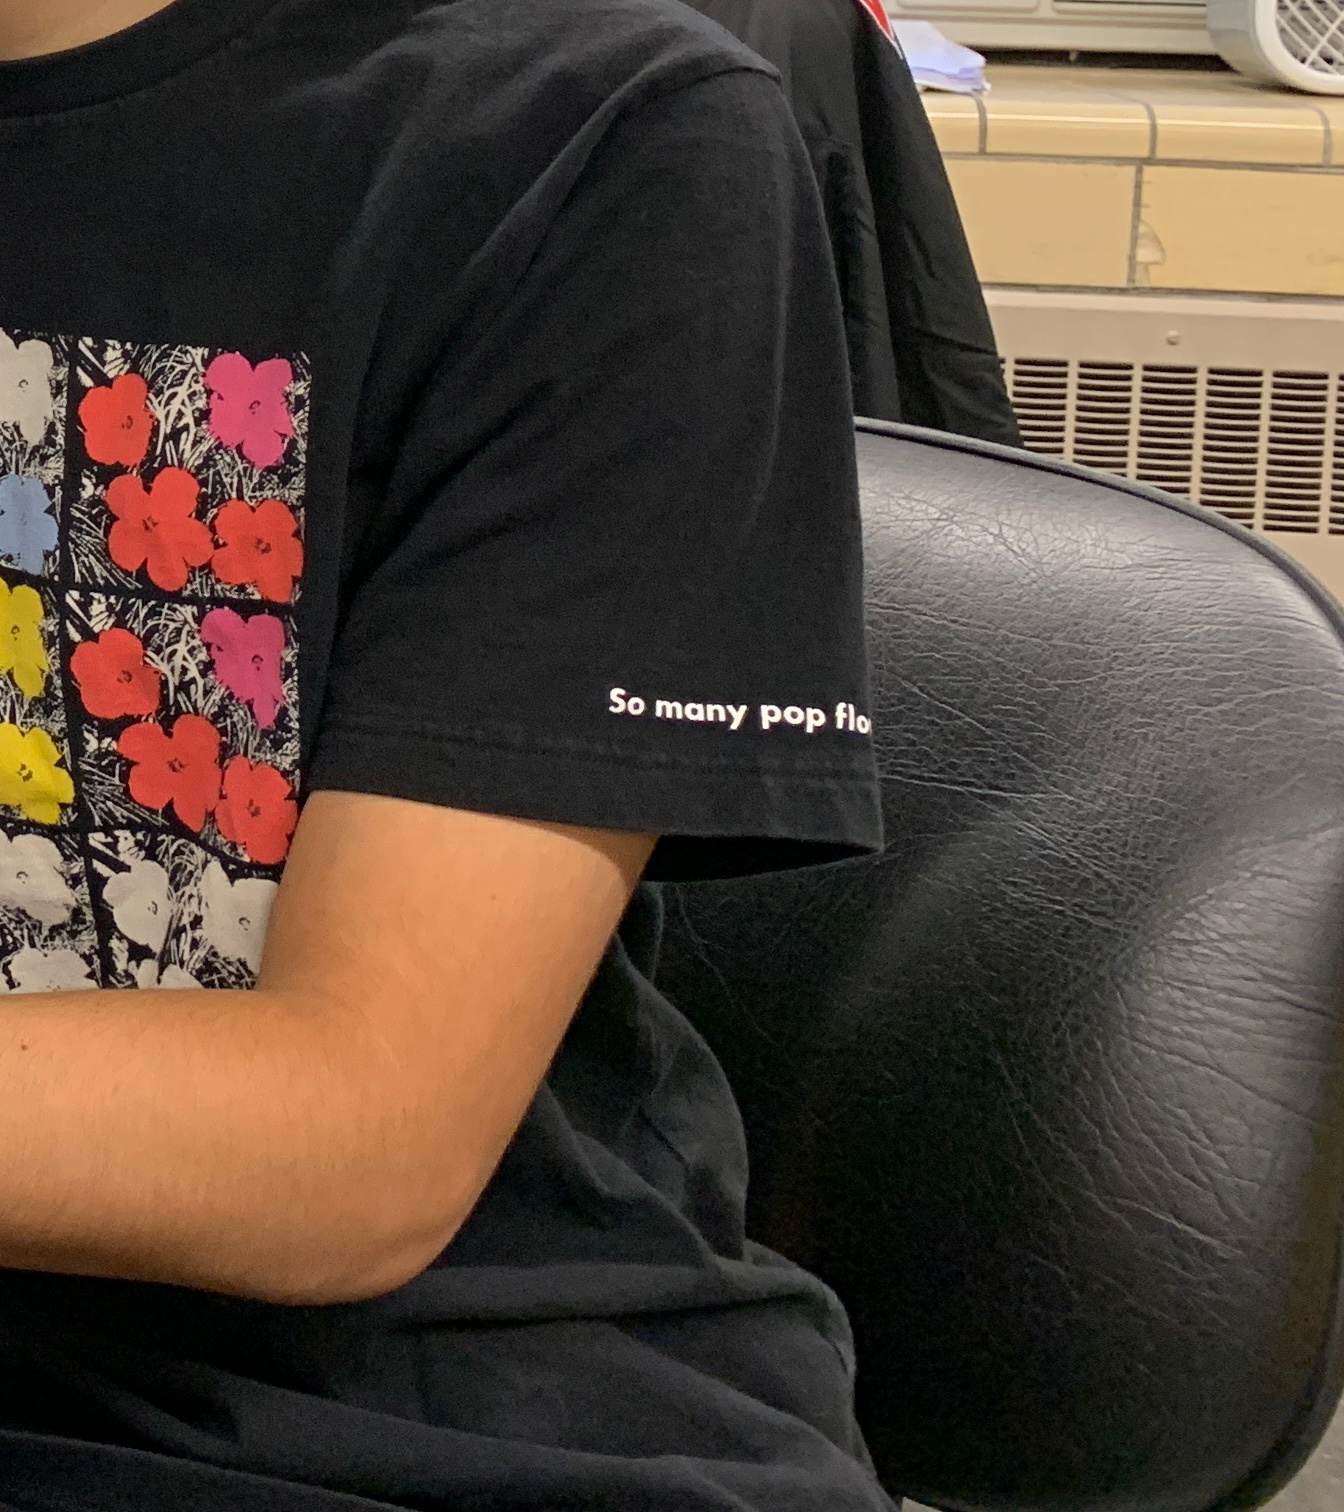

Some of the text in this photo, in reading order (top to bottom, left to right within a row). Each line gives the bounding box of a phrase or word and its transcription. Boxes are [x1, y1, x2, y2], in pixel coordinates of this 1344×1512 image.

[608, 687, 646, 717] So
[654, 696, 748, 731] many
[760, 701, 826, 735] pop
